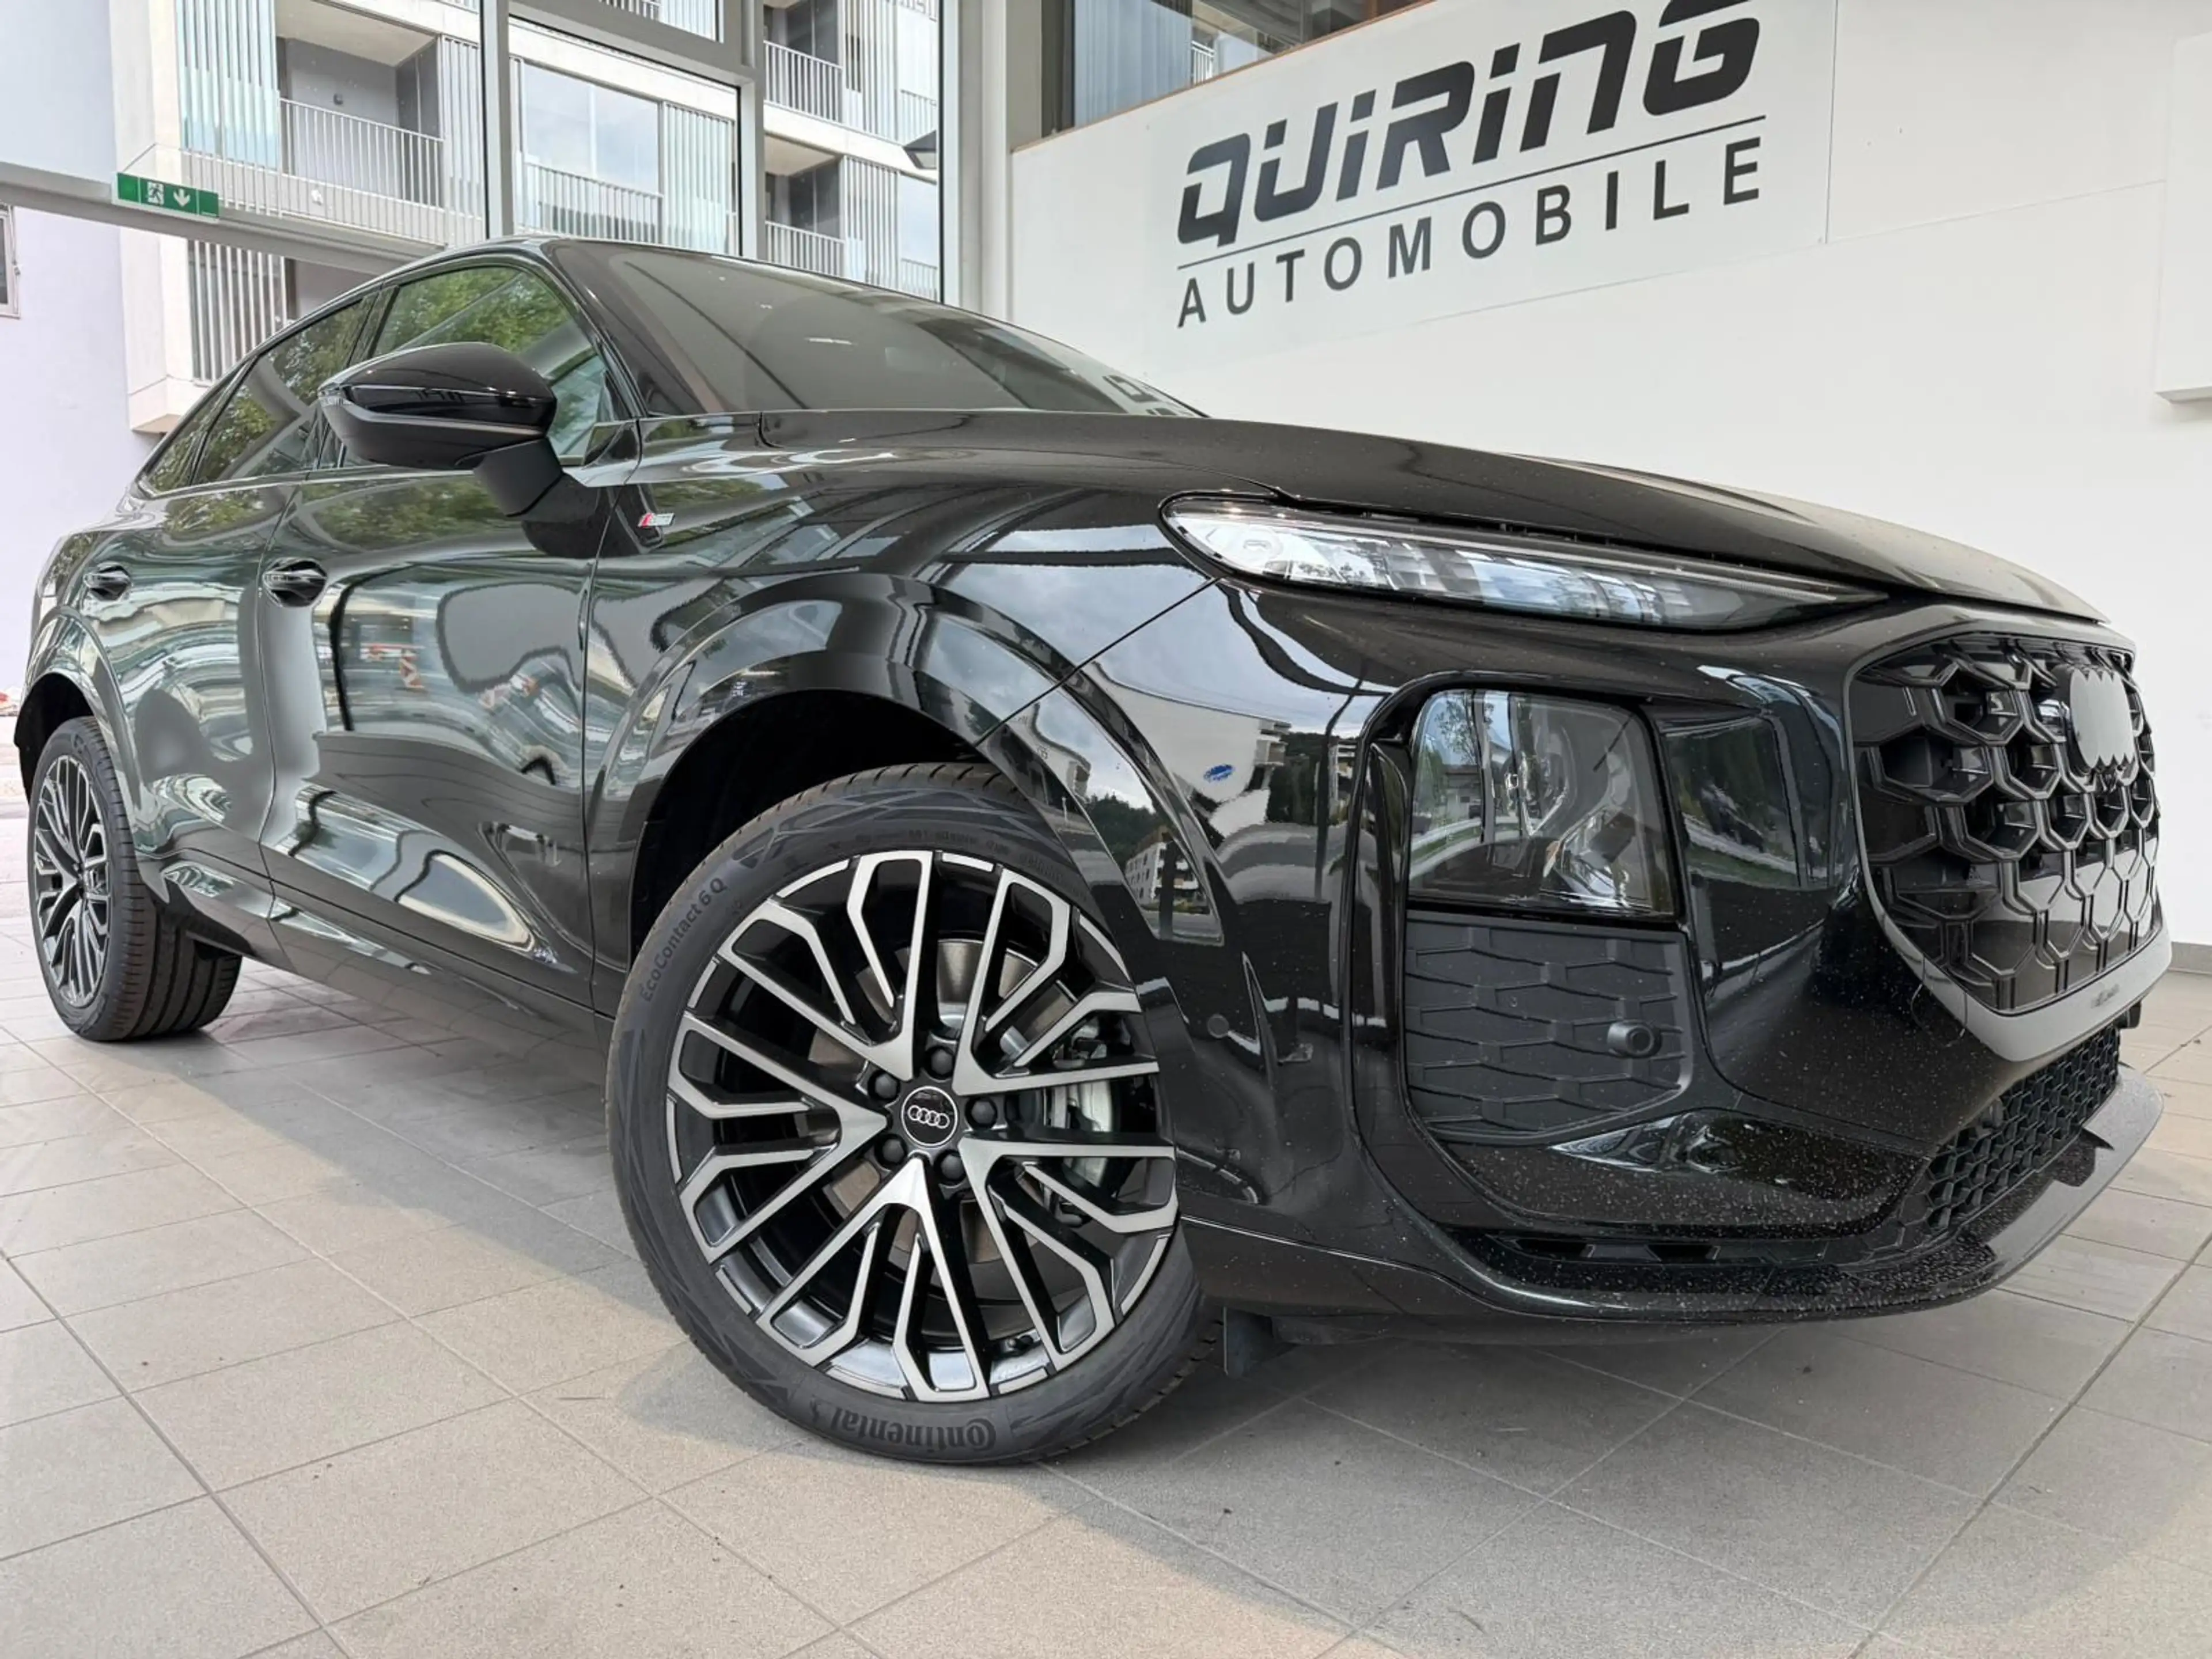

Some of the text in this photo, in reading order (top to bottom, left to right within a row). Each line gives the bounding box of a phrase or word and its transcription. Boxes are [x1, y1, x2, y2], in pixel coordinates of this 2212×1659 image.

[1177, 137, 1762, 328] AUTOMOBILE
[639, 877, 728, 1002] EcoContact 6 Q
[830, 1406, 997, 1453] Continental
